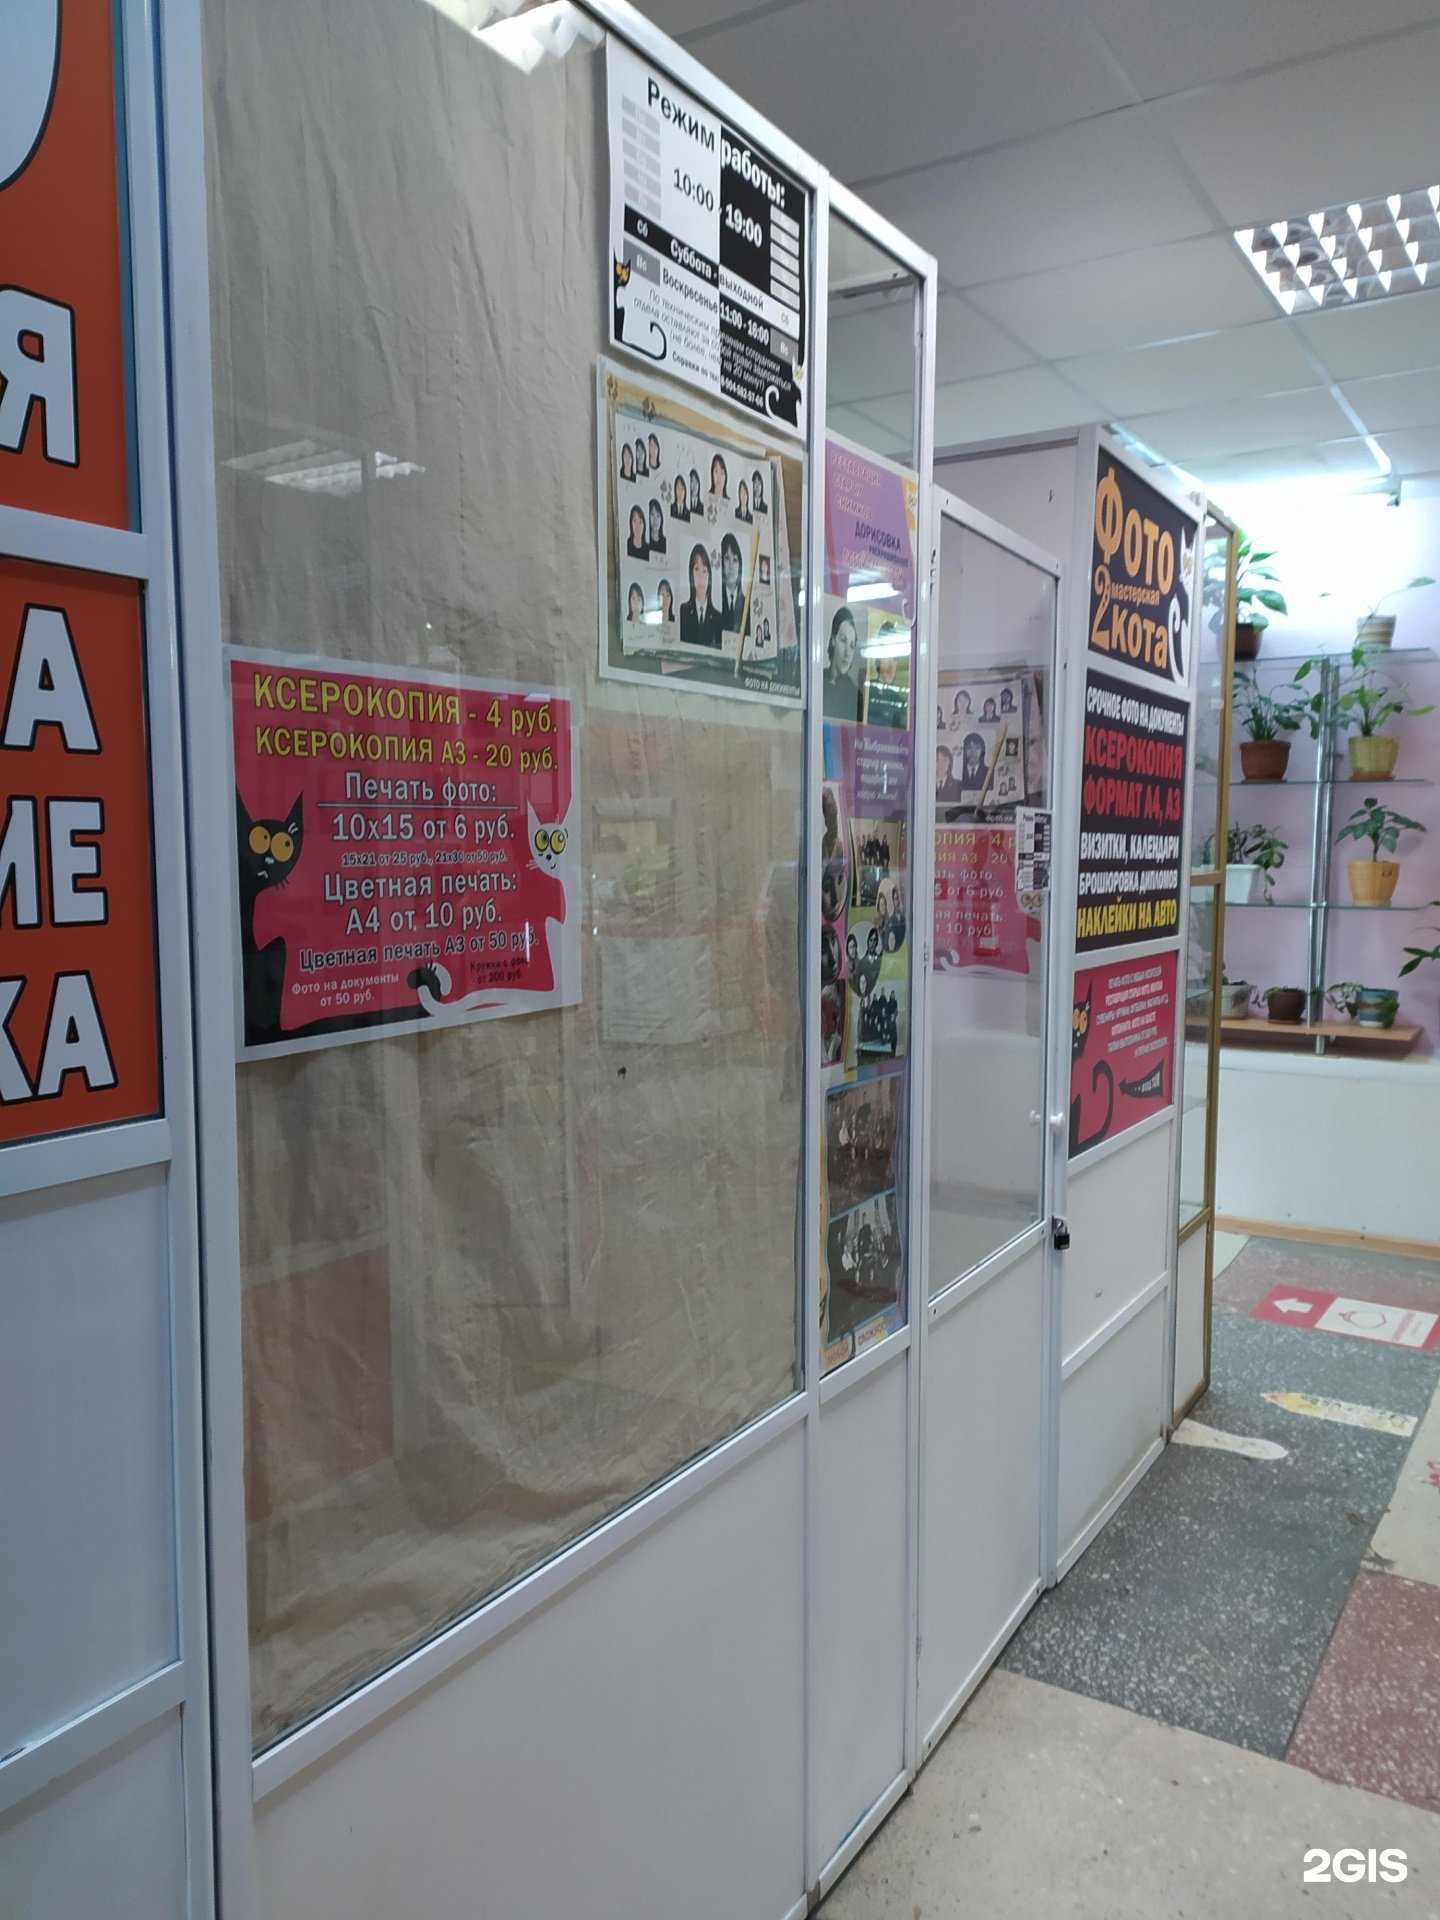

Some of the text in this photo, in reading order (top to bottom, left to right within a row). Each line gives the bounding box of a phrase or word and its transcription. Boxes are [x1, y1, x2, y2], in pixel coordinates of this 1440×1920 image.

[647, 76, 714, 152] Режим
[720, 137, 785, 208] работы:
[674, 168, 713, 212] 10:00
[725, 203, 763, 248] 19:00
[637, 219, 648, 238] Сб
[670, 238, 712, 279] Суббота
[720, 273, 764, 311] выходной
[663, 268, 718, 314] Воскресенье
[720, 301, 743, 330] 11:00
[254, 671, 461, 726] КСЕРОКОПИЯ
[486, 699, 502, 726] 4
[510, 703, 558, 735] руб.
[1086, 686, 1185, 737] СРОЧНОЕ ФОТО НА ДОКУМЕНТЫ
[255, 726, 434, 763] КСЕРОКОПИЯ
[441, 740, 468, 765] А3
[486, 743, 512, 768] 20
[519, 746, 558, 773] руб.
[1084, 723, 1183, 781] КСЕРОКОПИЯ
[345, 772, 497, 807] Печать фото:
[1083, 774, 1181, 826] ФОРМАТ А4, А3
[423, 820, 447, 839] от
[454, 814, 467, 840] 6
[473, 815, 515, 847] руб.
[1080, 832, 1180, 864] ВИЗИТКИ, КАЛЕНДАРИ
[379, 854, 390, 865] от
[392, 852, 407, 865] 25
[324, 871, 517, 906] Цветная печать:
[1079, 870, 1178, 896] БРОШЮРОВКА ДИПЛОМОВ
[346, 898, 503, 936] А4 от 10 руб.
[1076, 896, 1177, 938] НАКЛЕЙКИ НА АВТО
[299, 929, 539, 972] Цветная печать А3 от 50 руб.
[291, 971, 400, 995] Фото на документы
[319, 989, 375, 1007] от 50 руб.
